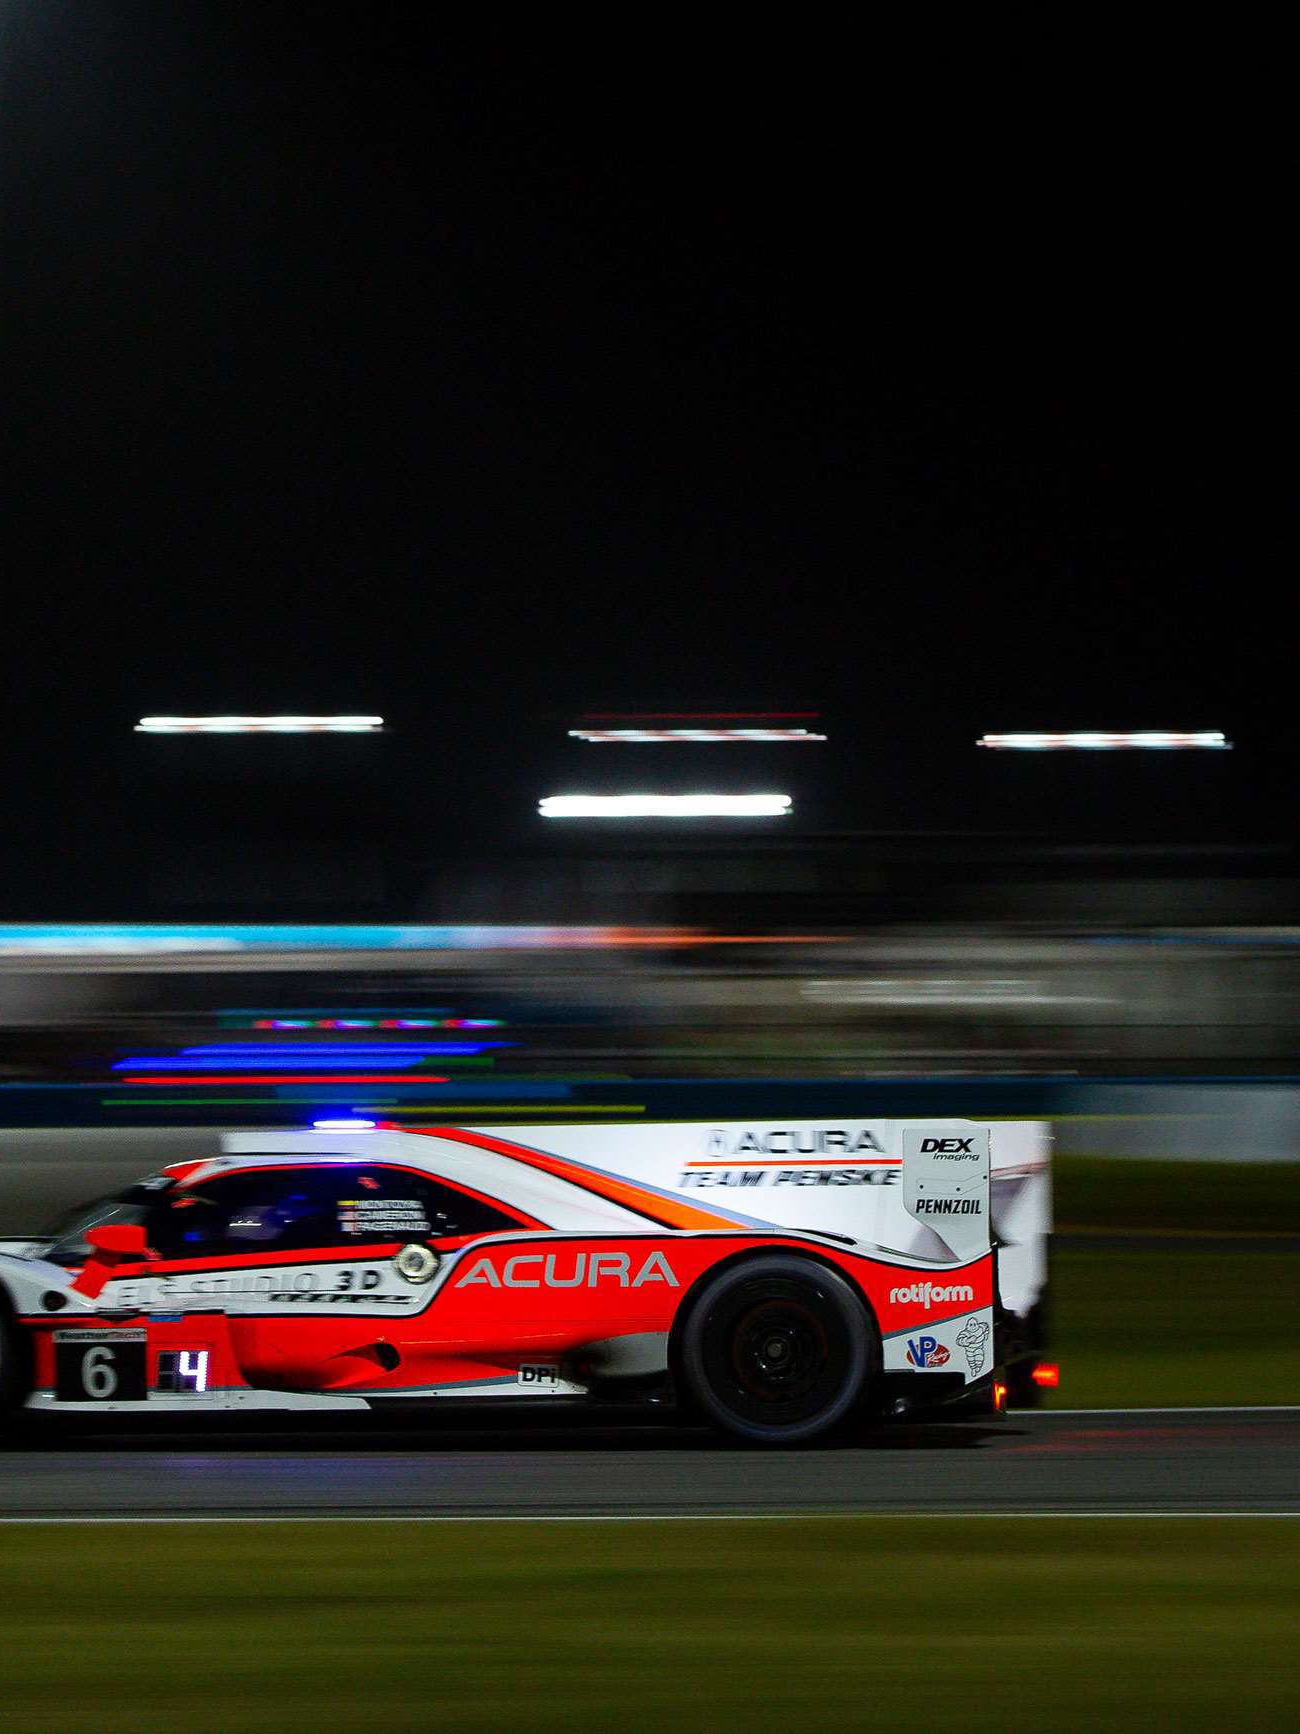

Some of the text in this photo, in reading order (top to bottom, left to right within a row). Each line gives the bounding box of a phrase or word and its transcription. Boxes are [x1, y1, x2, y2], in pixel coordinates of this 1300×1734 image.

[736, 1130, 887, 1153] ACURA
[920, 1138, 975, 1153] DEX
[933, 1152, 980, 1161] imaging
[679, 1169, 902, 1187] TEAM PENSKE
[915, 1199, 982, 1214] PENNZOIL
[335, 1270, 382, 1290] 3D
[454, 1251, 681, 1288] ACURA
[889, 1282, 974, 1309] rotiform
[907, 1336, 937, 1367] VP
[82, 1346, 118, 1398] 6
[179, 1351, 209, 1392] 4
[522, 1366, 557, 1383] DPi
